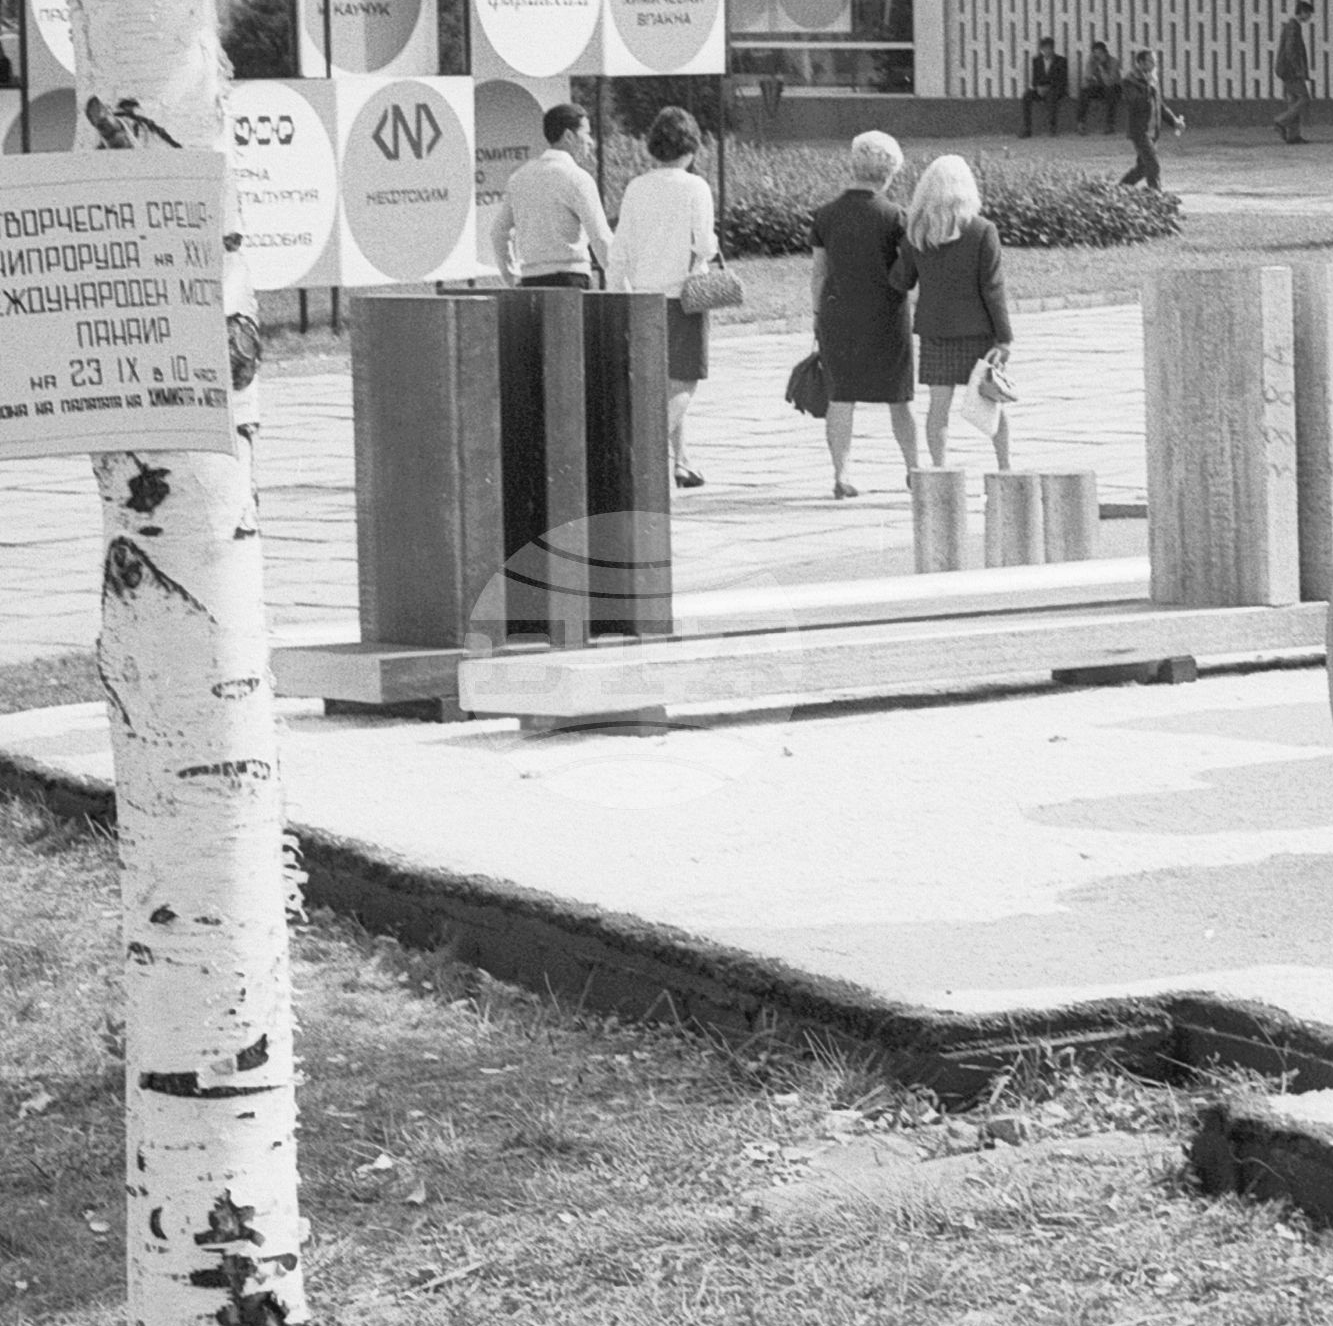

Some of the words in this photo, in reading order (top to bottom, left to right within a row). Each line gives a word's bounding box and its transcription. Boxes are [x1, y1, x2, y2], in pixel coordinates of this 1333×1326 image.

[637, 12, 692, 26] ВЛАКНА
[0, 202, 135, 239] ВОРЧЕСКА
[0, 277, 170, 317] ЖДУНАРОДЕН
[76, 316, 171, 349] ПАНАИР
[29, 375, 58, 391] НА
[69, 358, 103, 388] 23
[117, 356, 141, 383] IX
[170, 355, 189, 382] 10
[34, 400, 55, 416] НА
[125, 394, 143, 409] НА
